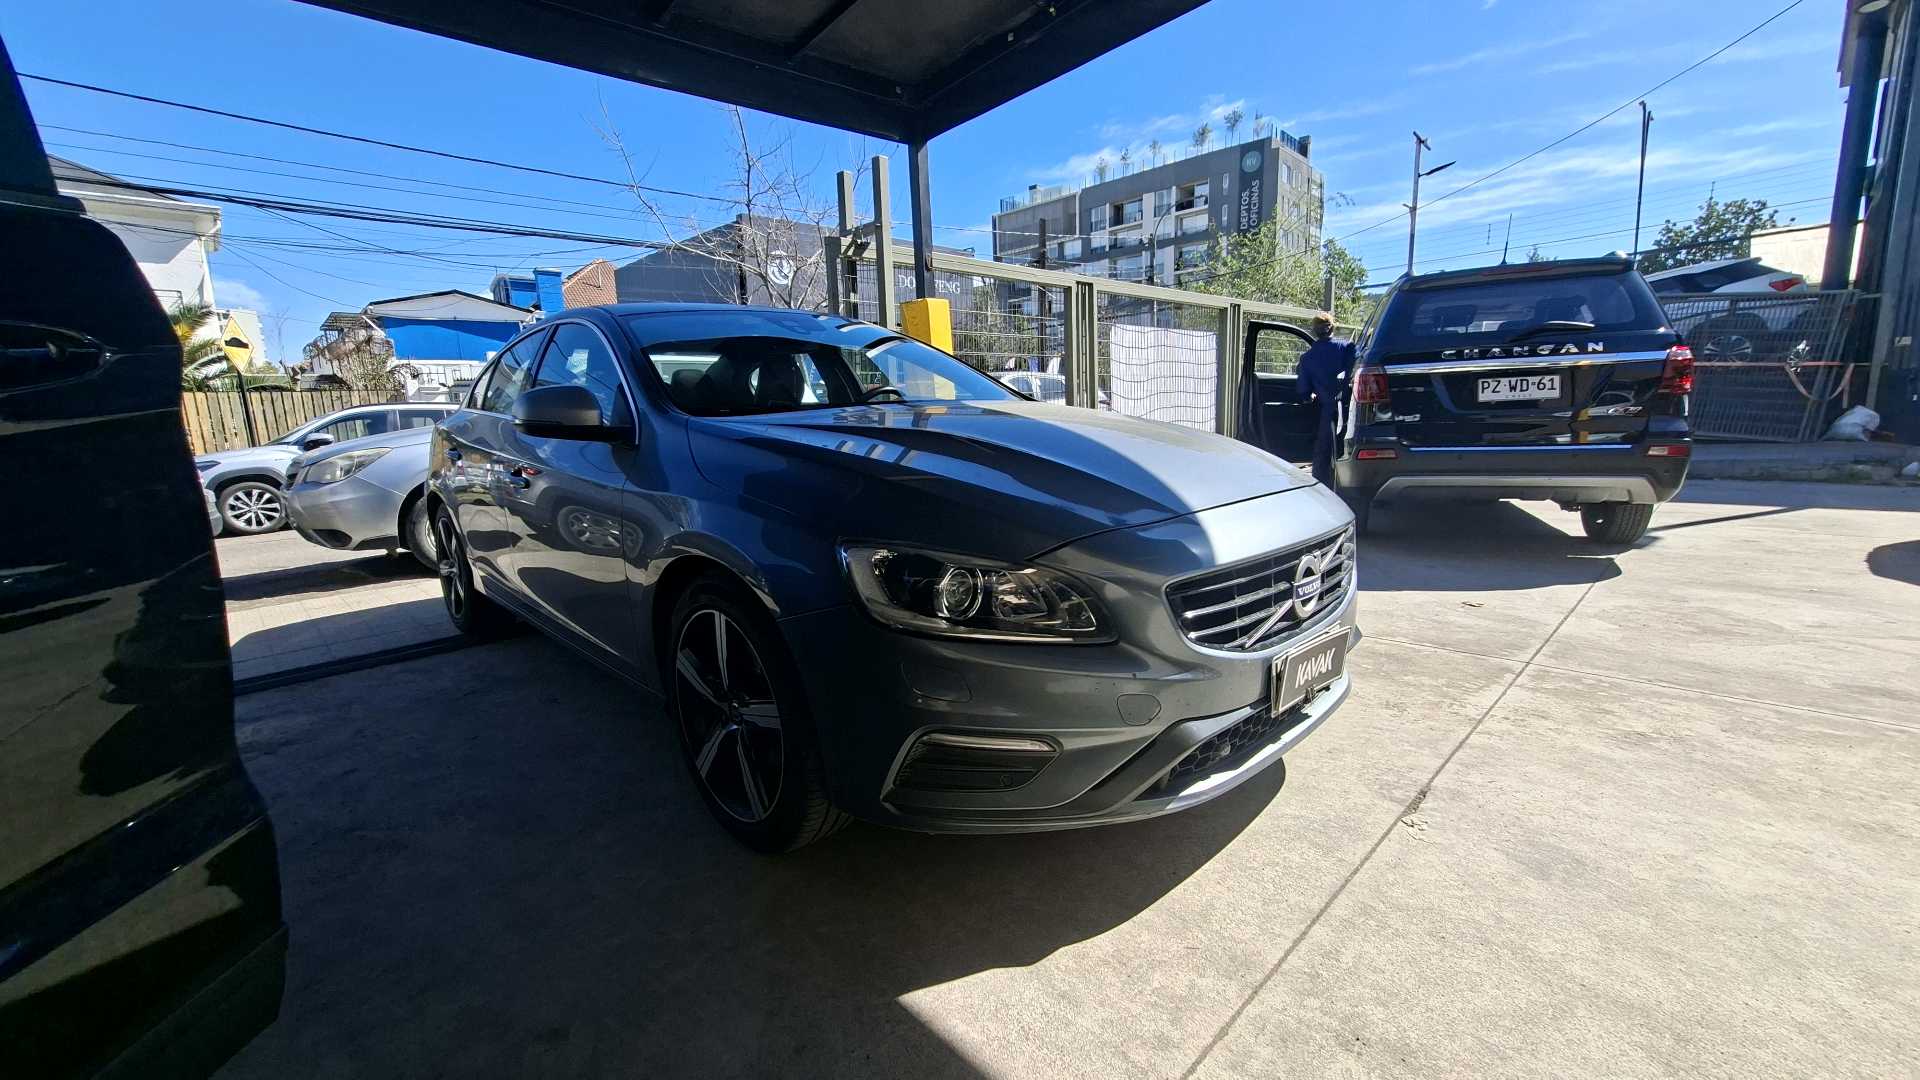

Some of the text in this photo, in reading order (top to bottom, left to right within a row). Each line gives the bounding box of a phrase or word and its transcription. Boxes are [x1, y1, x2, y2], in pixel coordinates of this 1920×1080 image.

[1249, 179, 1260, 226] OFICINAS
[1441, 341, 1604, 360] CHANGAN
[1297, 580, 1321, 596] VOLVO
[1295, 647, 1336, 689] KAVAK
